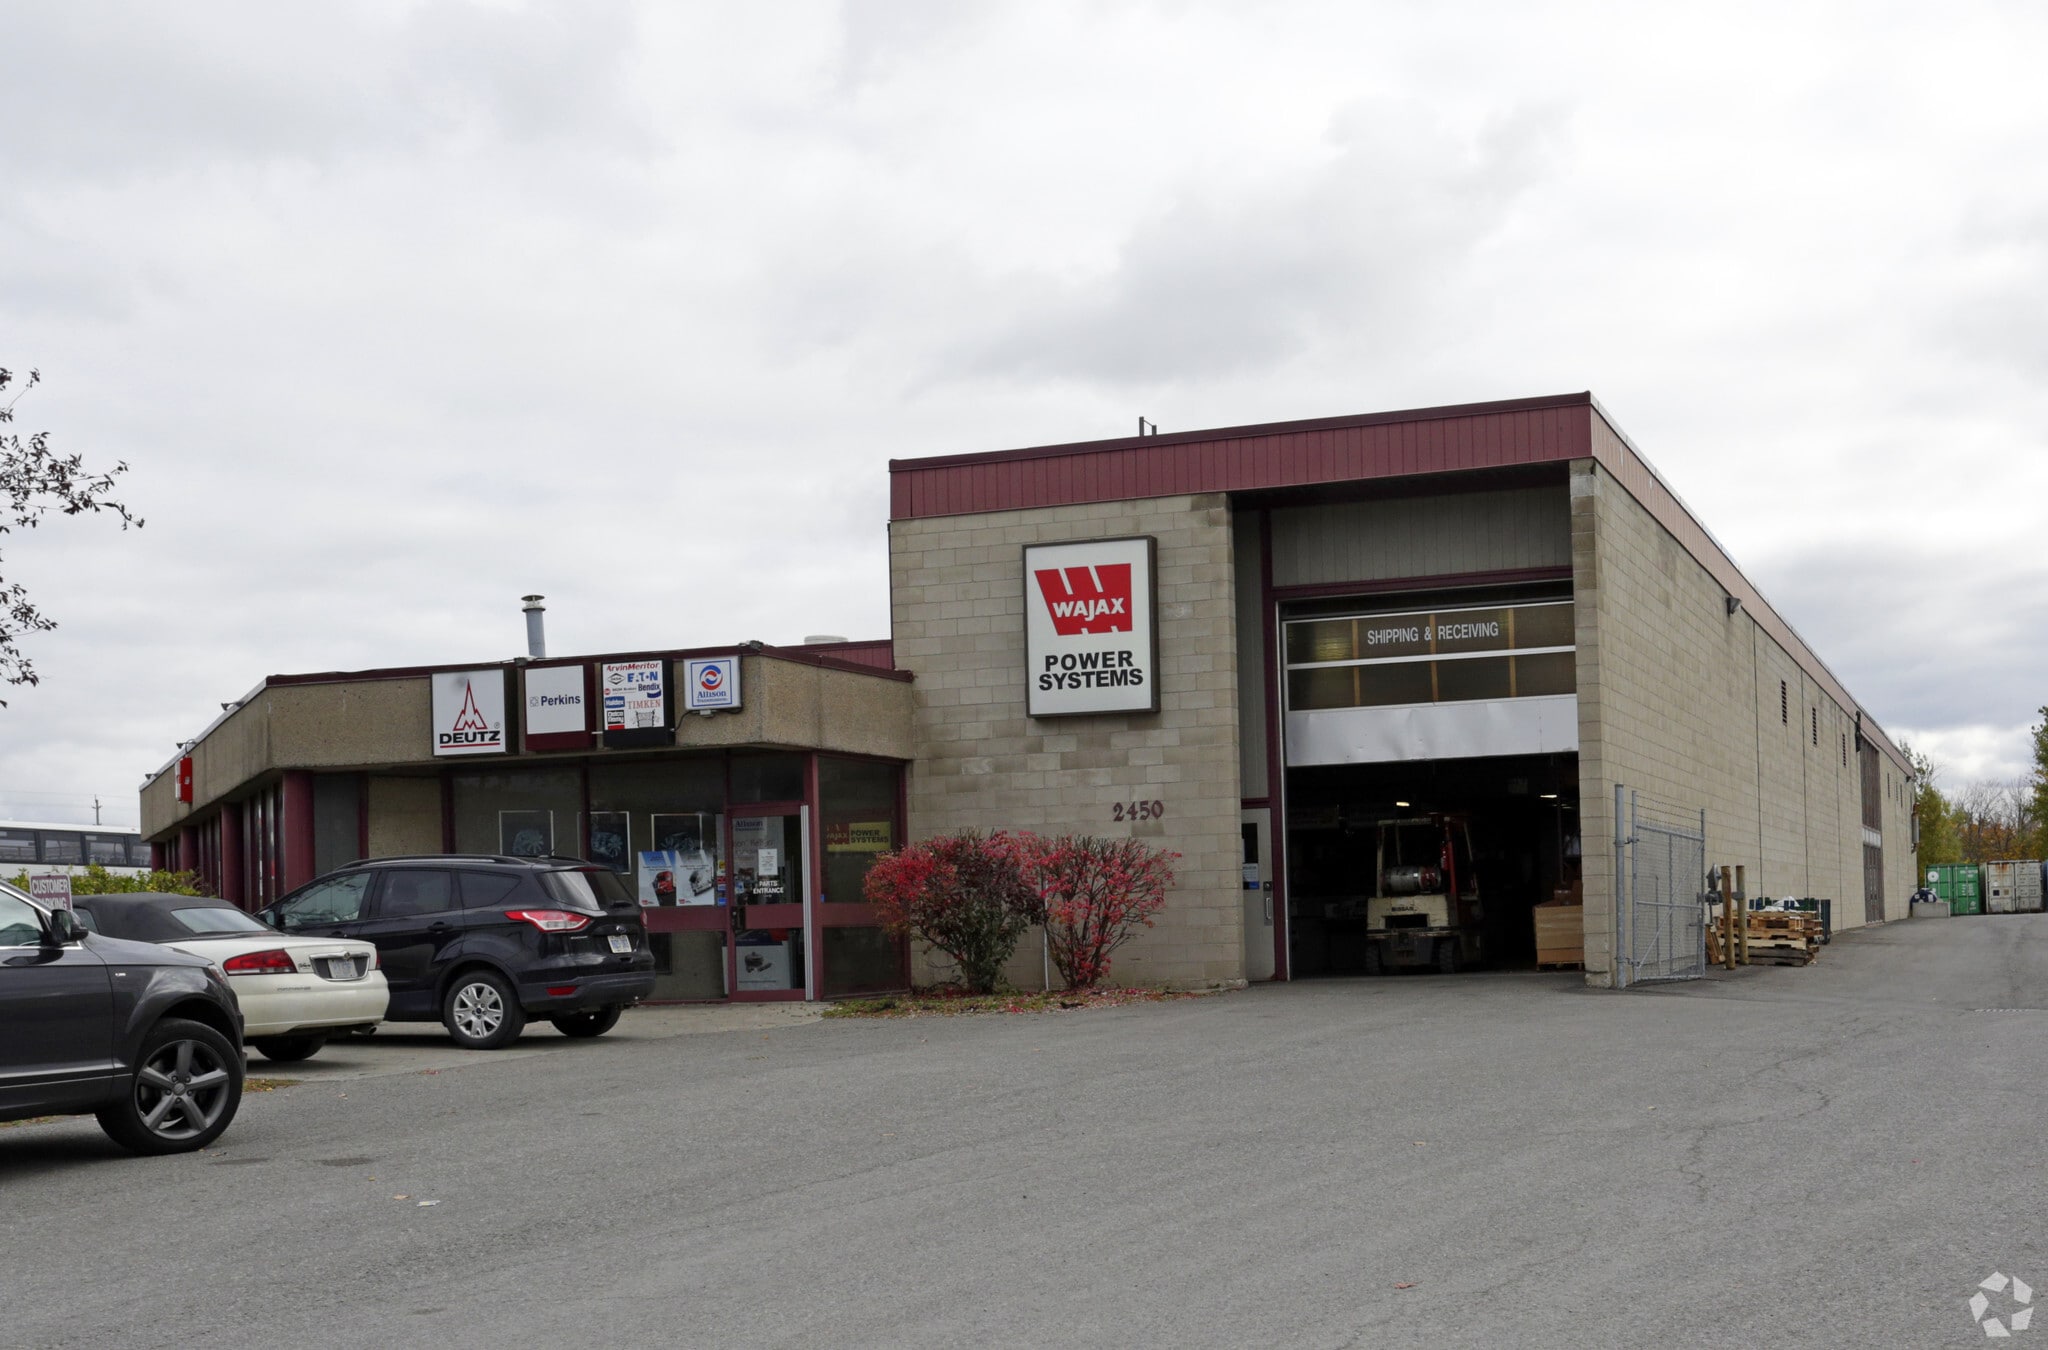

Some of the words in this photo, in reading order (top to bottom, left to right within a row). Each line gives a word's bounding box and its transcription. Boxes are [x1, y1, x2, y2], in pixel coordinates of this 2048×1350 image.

[1052, 597, 1126, 622] WAJAX
[1367, 627, 1419, 645] SHIPPING
[1424, 626, 1432, 641] &
[1437, 621, 1499, 640] RECEIVING
[607, 662, 660, 672] ArvinMeritor
[1045, 650, 1134, 673] POWER
[1038, 667, 1144, 691] SYSTEMS
[638, 683, 660, 691] Bendix
[540, 694, 581, 707] Perkins
[627, 699, 661, 709] TIMKEN
[439, 730, 501, 744] DEUTZ
[1113, 800, 1165, 822] 2450
[32, 878, 69, 894] CUSTOMER
[759, 880, 778, 888] PARTS
[752, 887, 784, 895] ENTRANCE
[38, 897, 68, 910] ARKING
